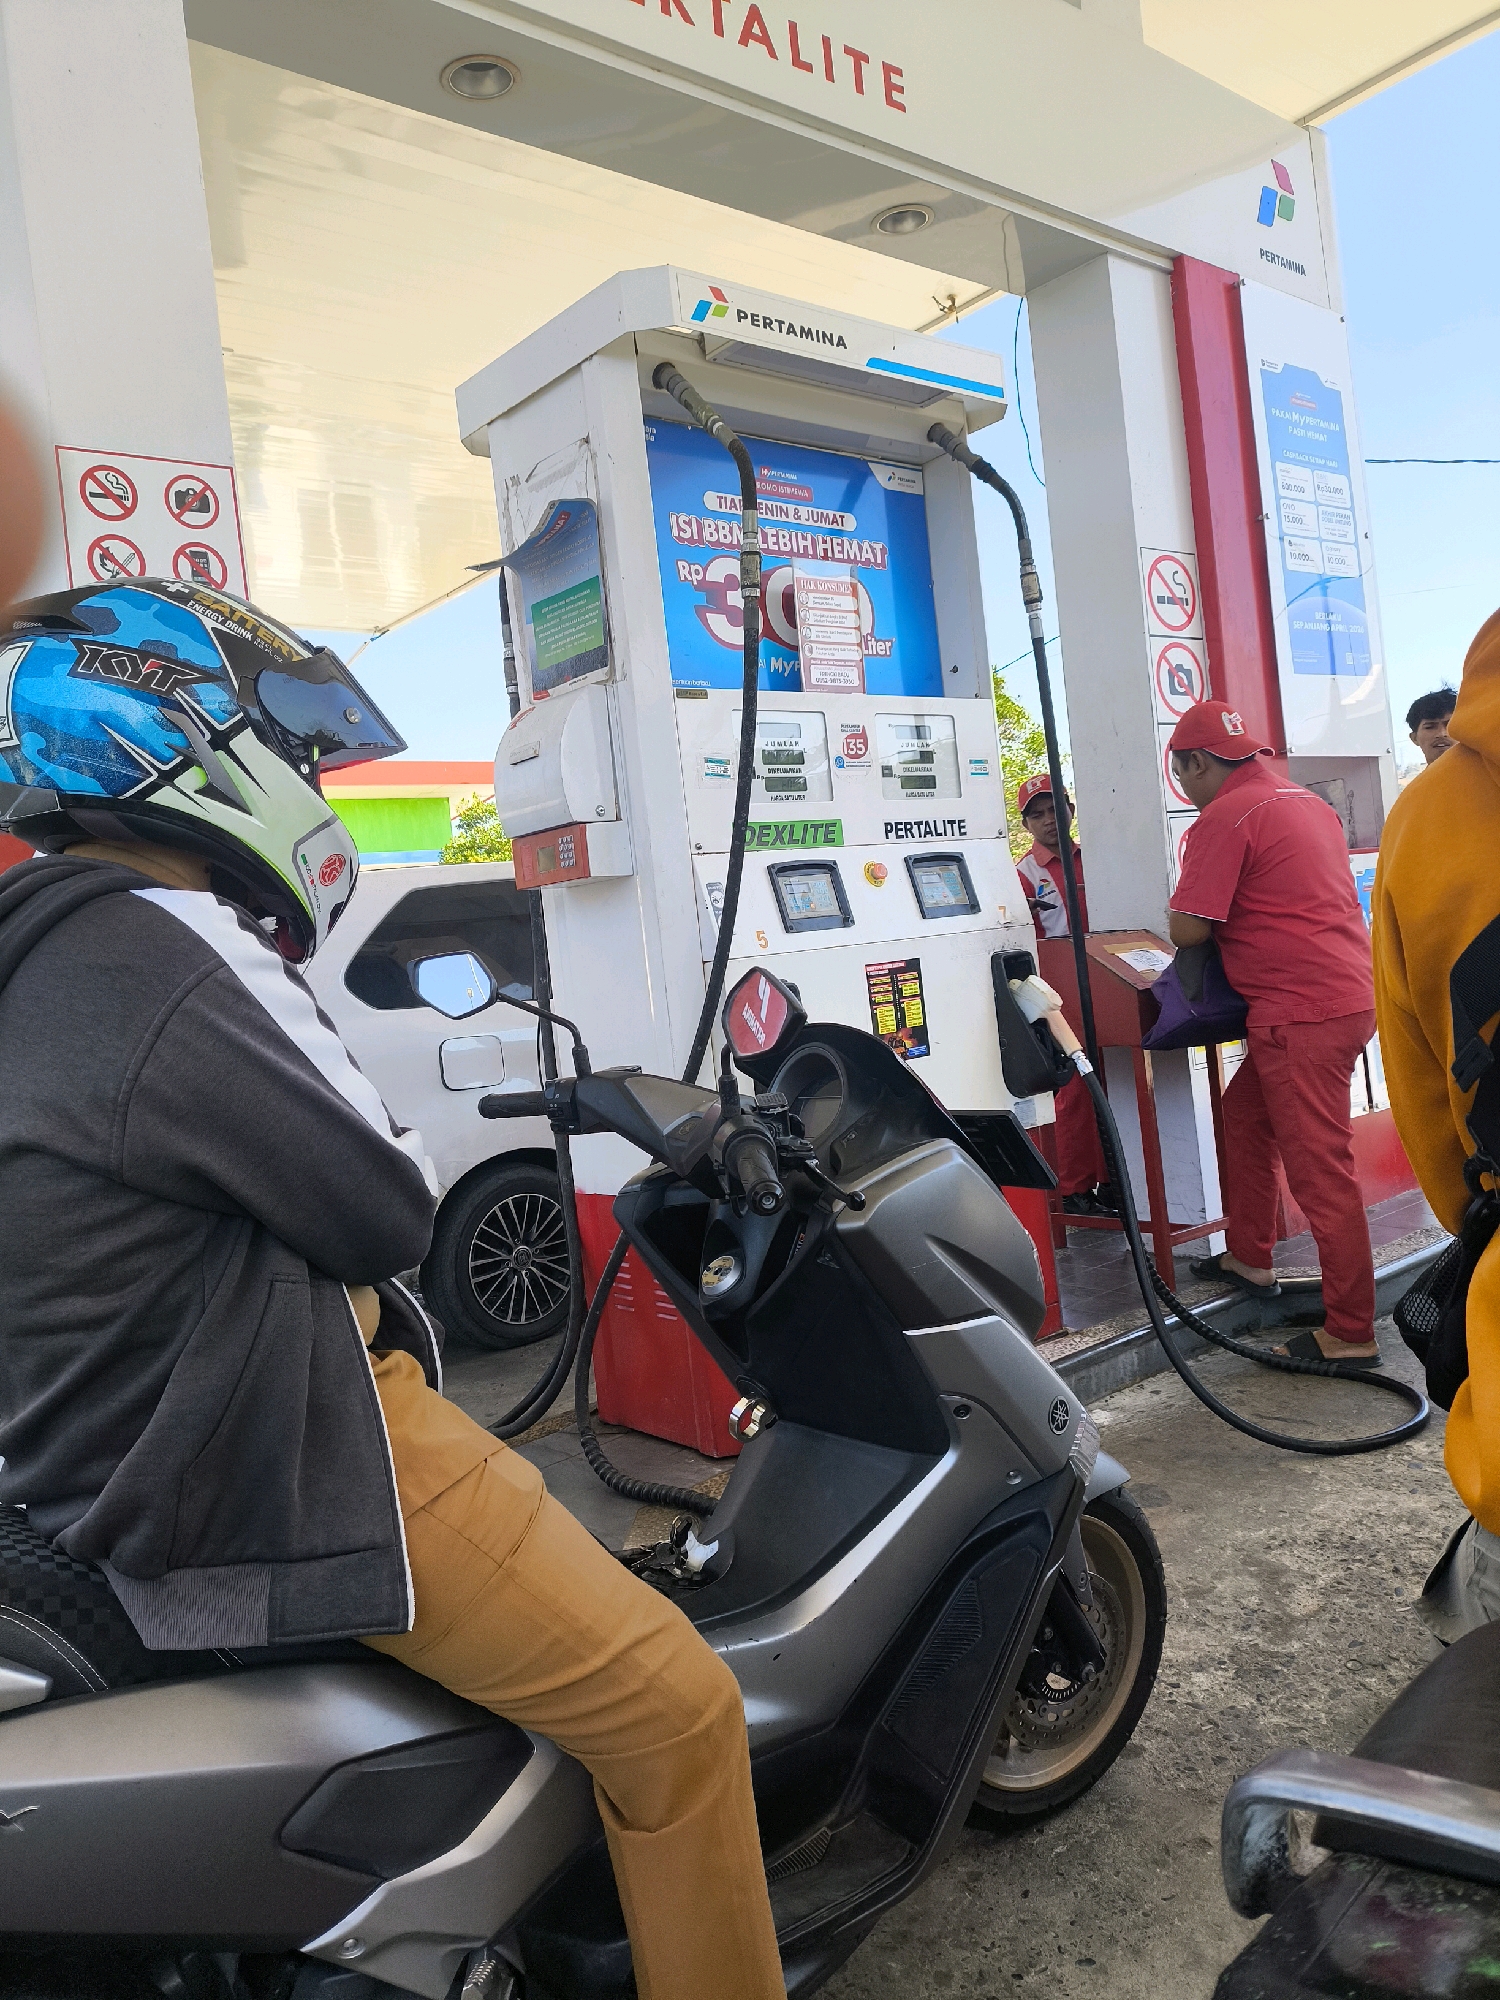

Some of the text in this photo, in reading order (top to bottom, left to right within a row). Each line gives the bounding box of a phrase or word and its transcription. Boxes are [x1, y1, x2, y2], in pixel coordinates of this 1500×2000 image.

[630, 0, 907, 113] TALITE
[1259, 247, 1307, 277] PERTAMINA
[736, 308, 848, 349] PERTAMINA
[1271, 407, 1340, 432] PAKAI MyPERTAMINA
[1288, 426, 1328, 443] PASTI HEMAT
[756, 481, 809, 498] ROMO ISTIMEWA
[757, 501, 790, 519] ENIN
[793, 507, 801, 520] &
[805, 509, 845, 527] JUMAT
[670, 512, 699, 540] ISI
[758, 527, 813, 555] LEBIH
[817, 535, 883, 564] HEMAT
[679, 560, 704, 585] Rp
[801, 580, 816, 589] HAK
[187, 600, 253, 641] ENERGY DRINK
[193, 591, 304, 662] BATTERY
[1293, 620, 1330, 632] SEPANJANG
[1331, 623, 1348, 633] APRIL
[1315, 611, 1342, 622] BERLAKU
[78, 644, 202, 691] KYT
[843, 738, 866, 755] 135
[745, 822, 837, 846] DEXLITE
[884, 819, 967, 839] PERTALITE
[756, 930, 768, 949] 5
